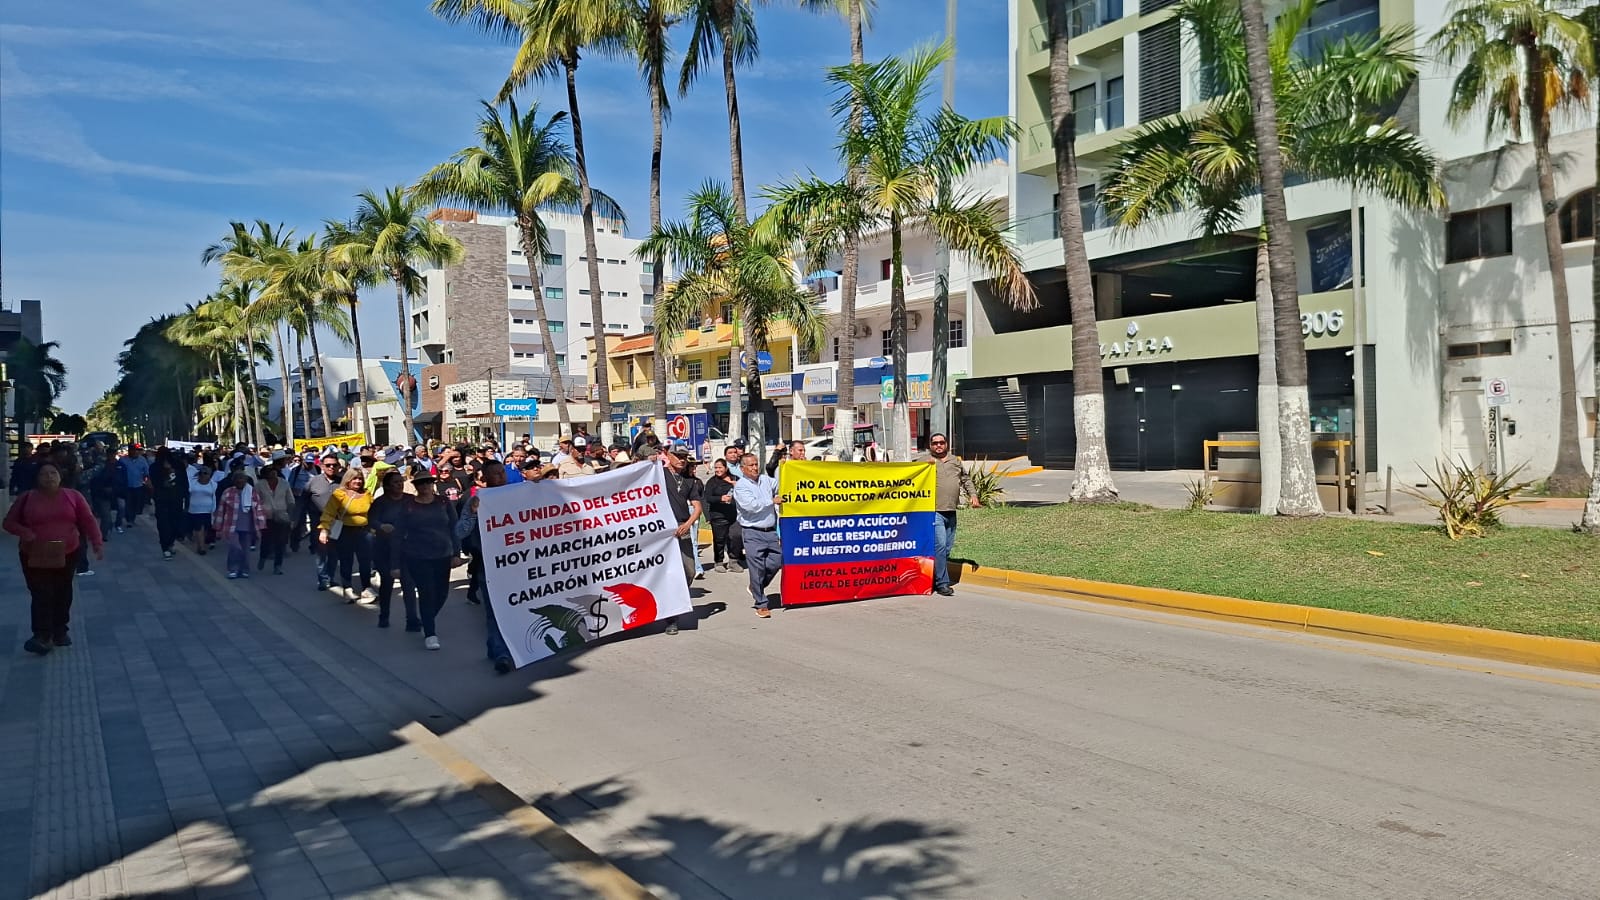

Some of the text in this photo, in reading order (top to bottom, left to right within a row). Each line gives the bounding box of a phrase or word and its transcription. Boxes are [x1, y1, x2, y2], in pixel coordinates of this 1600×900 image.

[1301, 309, 1344, 335] 306
[1493, 383, 1502, 393] E
[498, 403, 533, 411] Comex
[796, 478, 915, 491] ¡NO AL CONTRABANDO,
[781, 490, 931, 504] SÍ AL PRODUCTOR NACIONAL!
[485, 483, 661, 532] ¡LA UNIDAD DEL SECTOR
[504, 503, 659, 546] ES NUESTRA FUERZA!
[799, 515, 908, 531] ¡EL CAMPO ACUÍCOLA
[495, 519, 667, 569] HOY MARCHAMOS POR
[812, 529, 898, 543] EXIGE RESPALDO
[793, 540, 917, 557] DE NUESTRO GOBIERNO!
[527, 543, 643, 581] EL FUTURO DEL
[835, 567, 848, 576] AL
[850, 563, 898, 575] CAMARÓN
[508, 553, 666, 606] CAMARÓN MEXICANO
[800, 579, 835, 590] ILEGAL
[837, 578, 850, 588] DE
